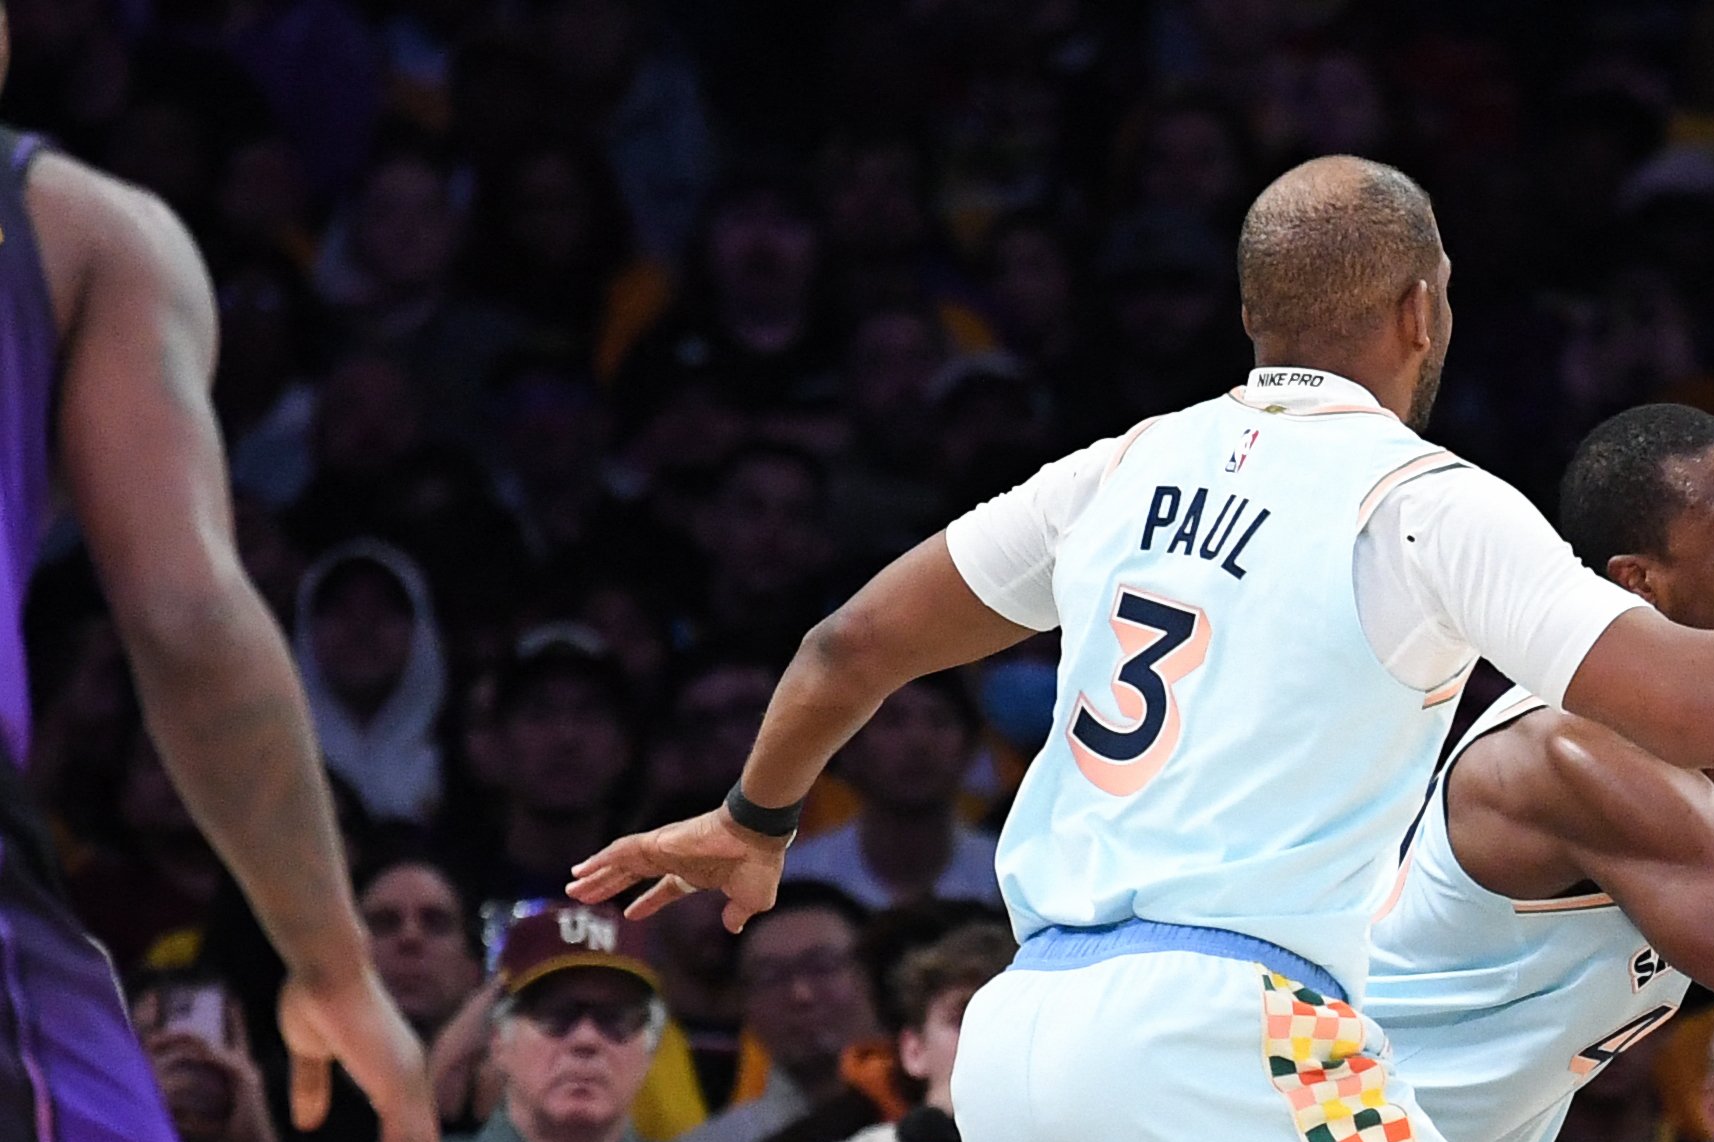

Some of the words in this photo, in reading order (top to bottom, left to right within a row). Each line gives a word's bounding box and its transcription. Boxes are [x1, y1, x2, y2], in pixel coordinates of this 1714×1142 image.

[1257, 373, 1287, 387] NIKE
[1288, 373, 1324, 387] PRO
[1140, 486, 1271, 580] PAUL
[1067, 588, 1203, 772] 3
